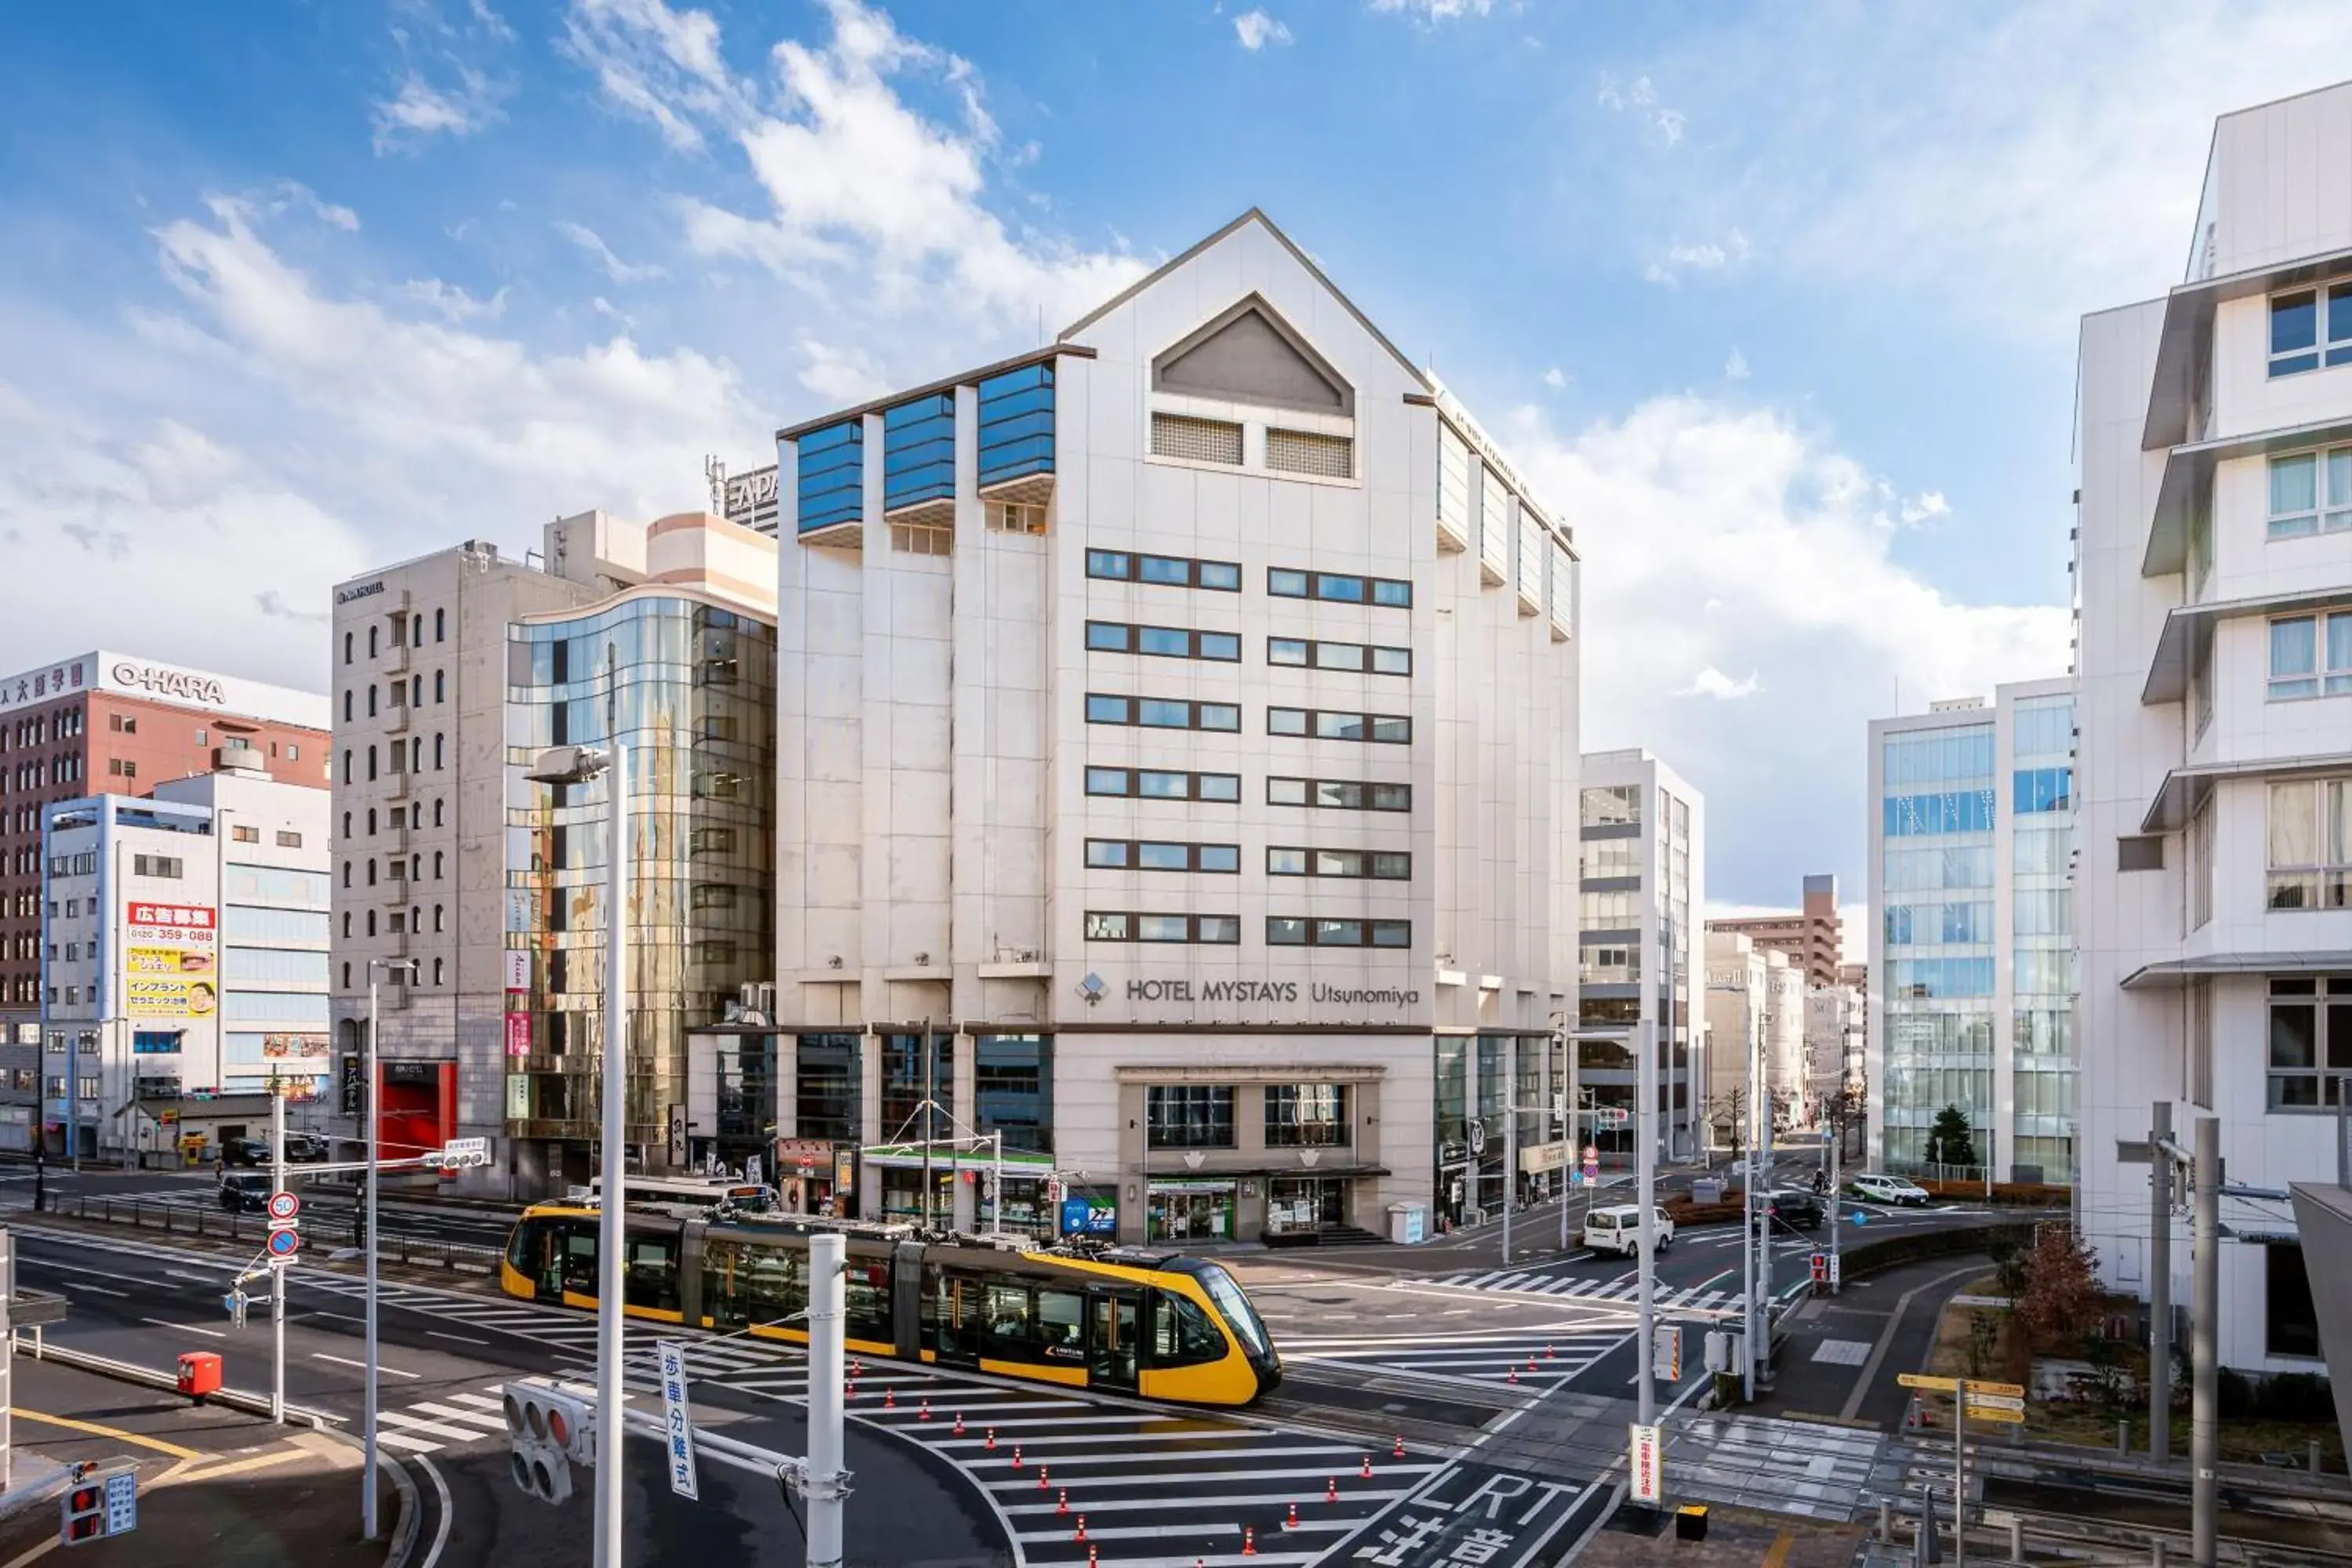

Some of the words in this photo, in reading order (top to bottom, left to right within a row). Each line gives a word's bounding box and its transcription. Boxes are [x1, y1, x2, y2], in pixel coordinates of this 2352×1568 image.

[113, 662, 226, 704] O-HARA
[135, 906, 209, 926] 広告募集
[131, 930, 154, 938] 0120
[132, 982, 187, 991] インプラント
[1127, 980, 1195, 1000] HOTEL
[1203, 982, 1297, 1002] MYSTAYS
[1312, 982, 1418, 1008] Utsunomiya
[276, 1200, 292, 1211] 50
[666, 1354, 690, 1488] 歩車分離式
[1409, 1467, 1581, 1525] LRT
